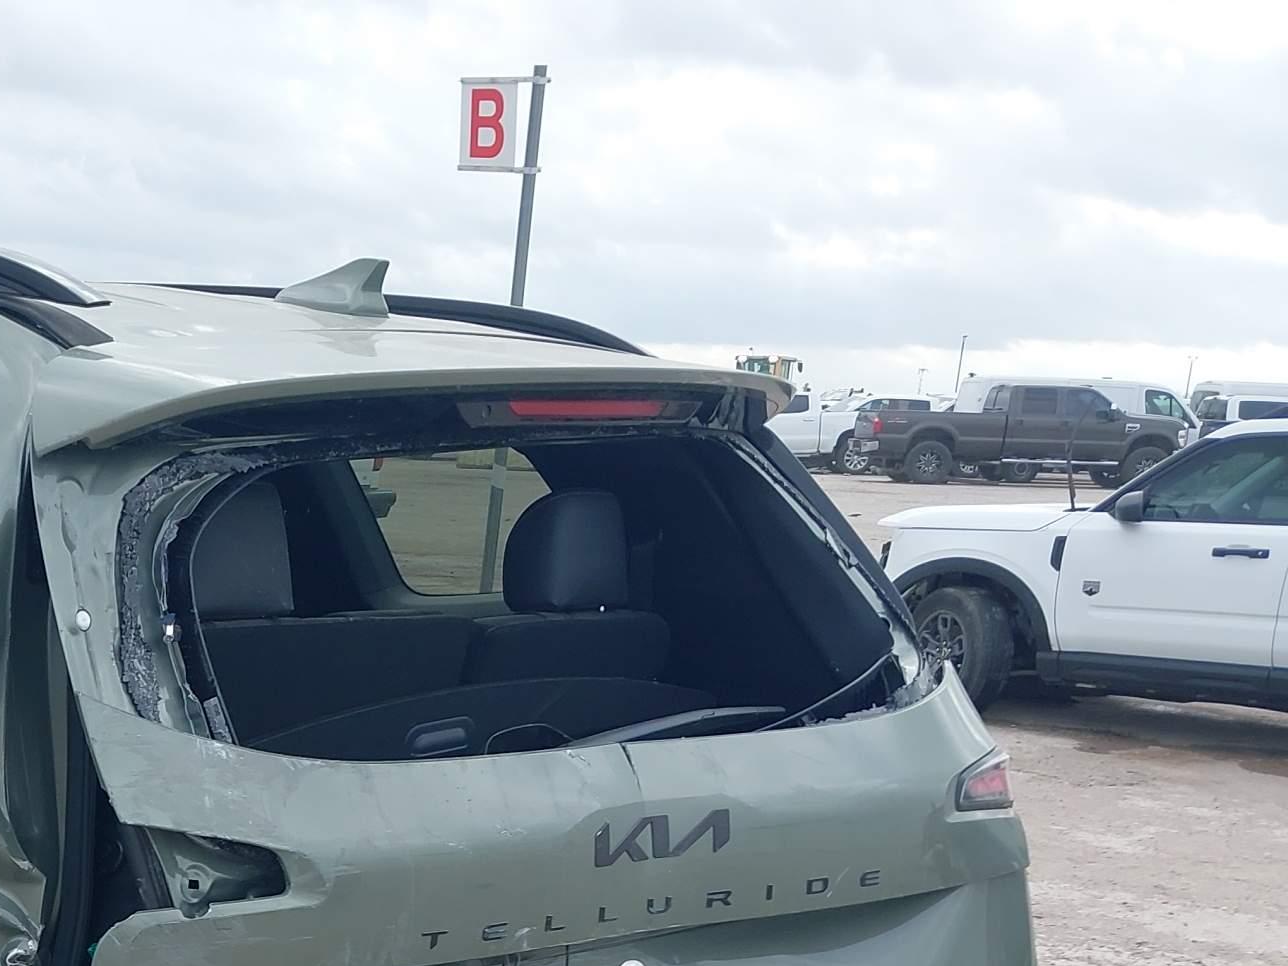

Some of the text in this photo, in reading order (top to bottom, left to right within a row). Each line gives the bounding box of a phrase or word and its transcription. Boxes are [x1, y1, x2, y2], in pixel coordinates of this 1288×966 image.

[470, 88, 505, 159] B
[594, 808, 731, 868] KIA
[421, 869, 882, 951] TELLURIDE
